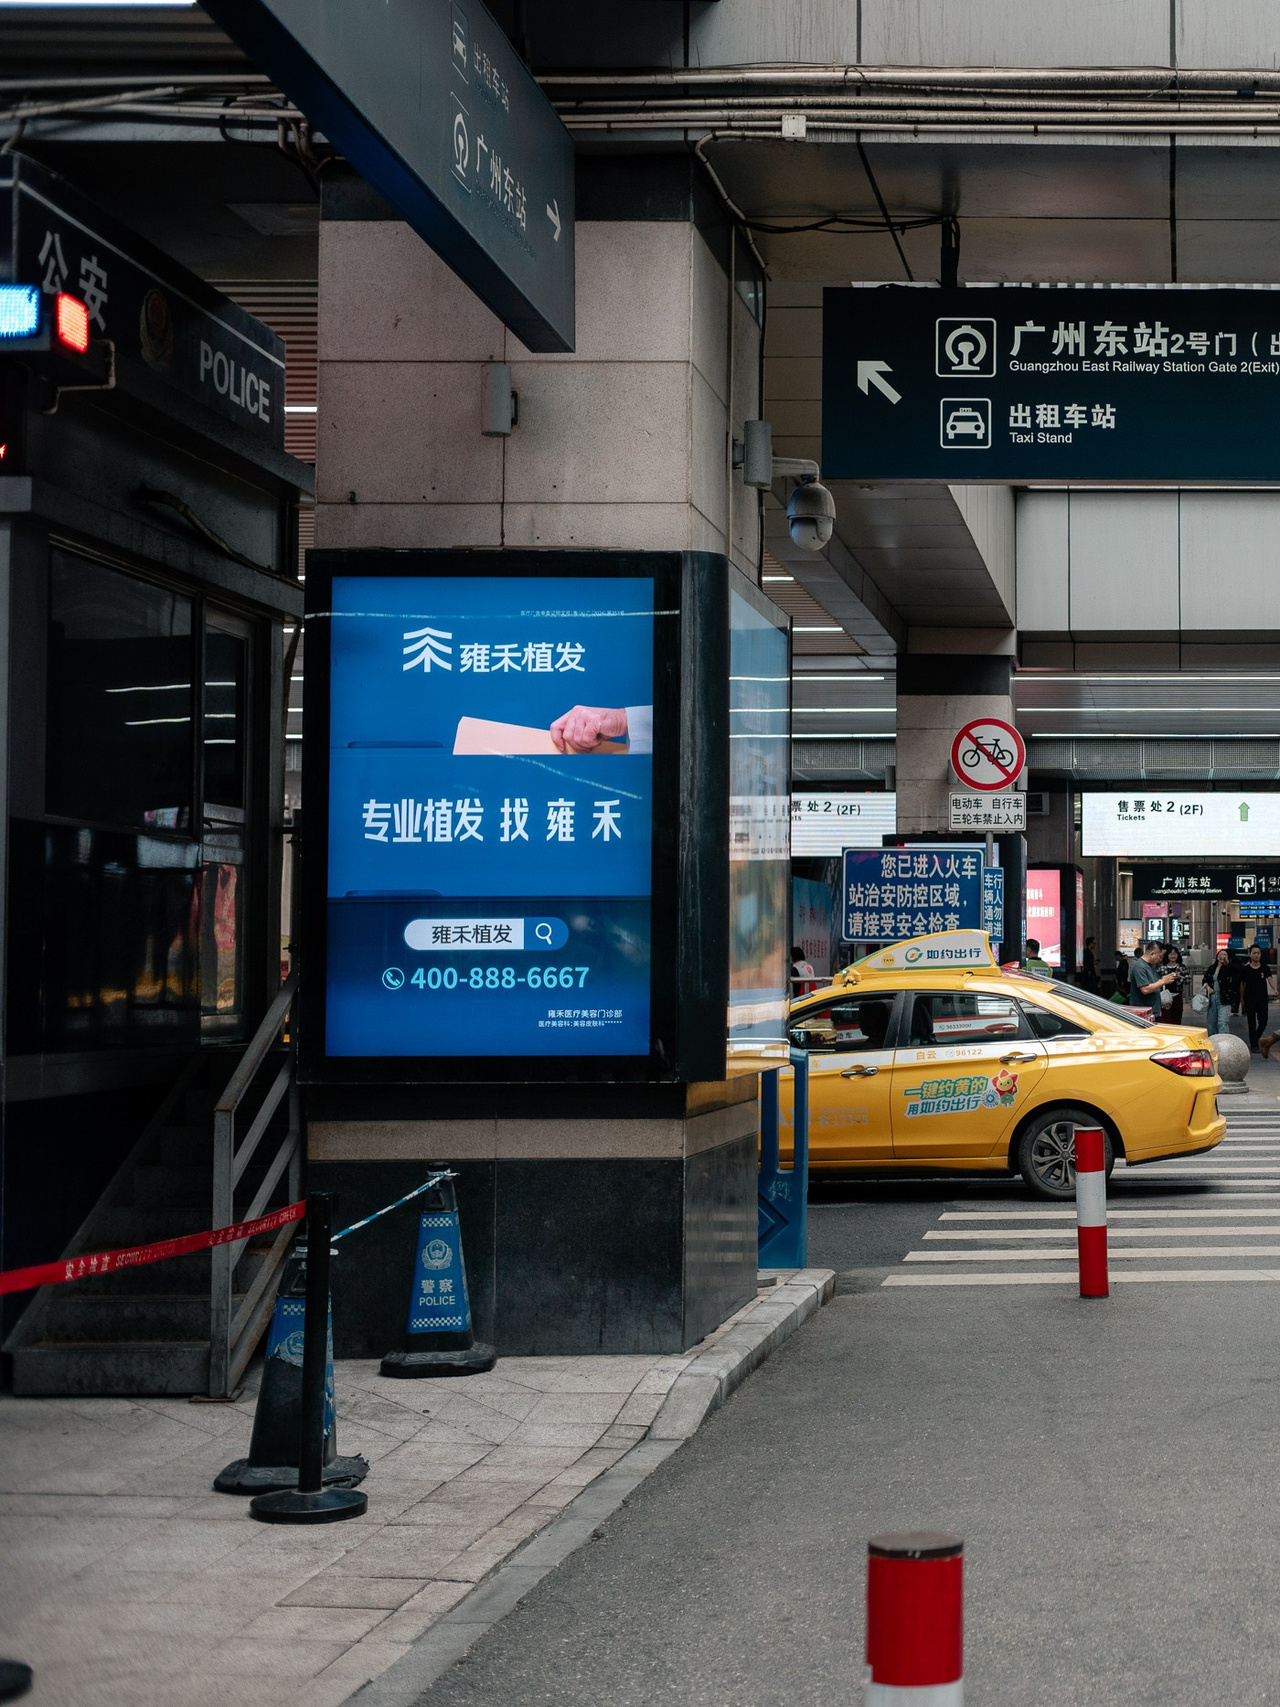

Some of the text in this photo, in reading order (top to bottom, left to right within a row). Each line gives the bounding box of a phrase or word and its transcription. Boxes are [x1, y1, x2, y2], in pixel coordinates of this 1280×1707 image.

[475, 133, 527, 232] 广州东站
[38, 231, 109, 331] 公安
[1009, 360, 1280, 375] Guangzhou East Railway Station Gate 2(Exit)
[199, 340, 271, 424] POLICE
[1008, 403, 1117, 429] 出租车站
[1009, 432, 1072, 443] Taxi Stand
[459, 642, 586, 673] 雍禾植发
[836, 803, 861, 816] (2F)
[952, 797, 1023, 809] 电动车 自行车
[1179, 803, 1204, 816] (2F)
[362, 798, 623, 843] 专业植发 找 雍 禾
[952, 813, 1023, 825] 三轮车禁止入内
[1117, 814, 1146, 822] Tickets
[880, 854, 977, 879] 您已进入火车
[1161, 876, 1211, 888] 广州东站
[431, 924, 513, 945] 雍禾植发
[926, 947, 982, 960] 如约出行
[411, 966, 590, 989] 400-888-6667
[548, 1009, 623, 1019] 雍禾医疗美容门诊部
[916, 1051, 937, 1060] 白云
[904, 1076, 989, 1100] 一键约黄的
[421, 1278, 453, 1293] 警察
[418, 1294, 457, 1307] POLICE
